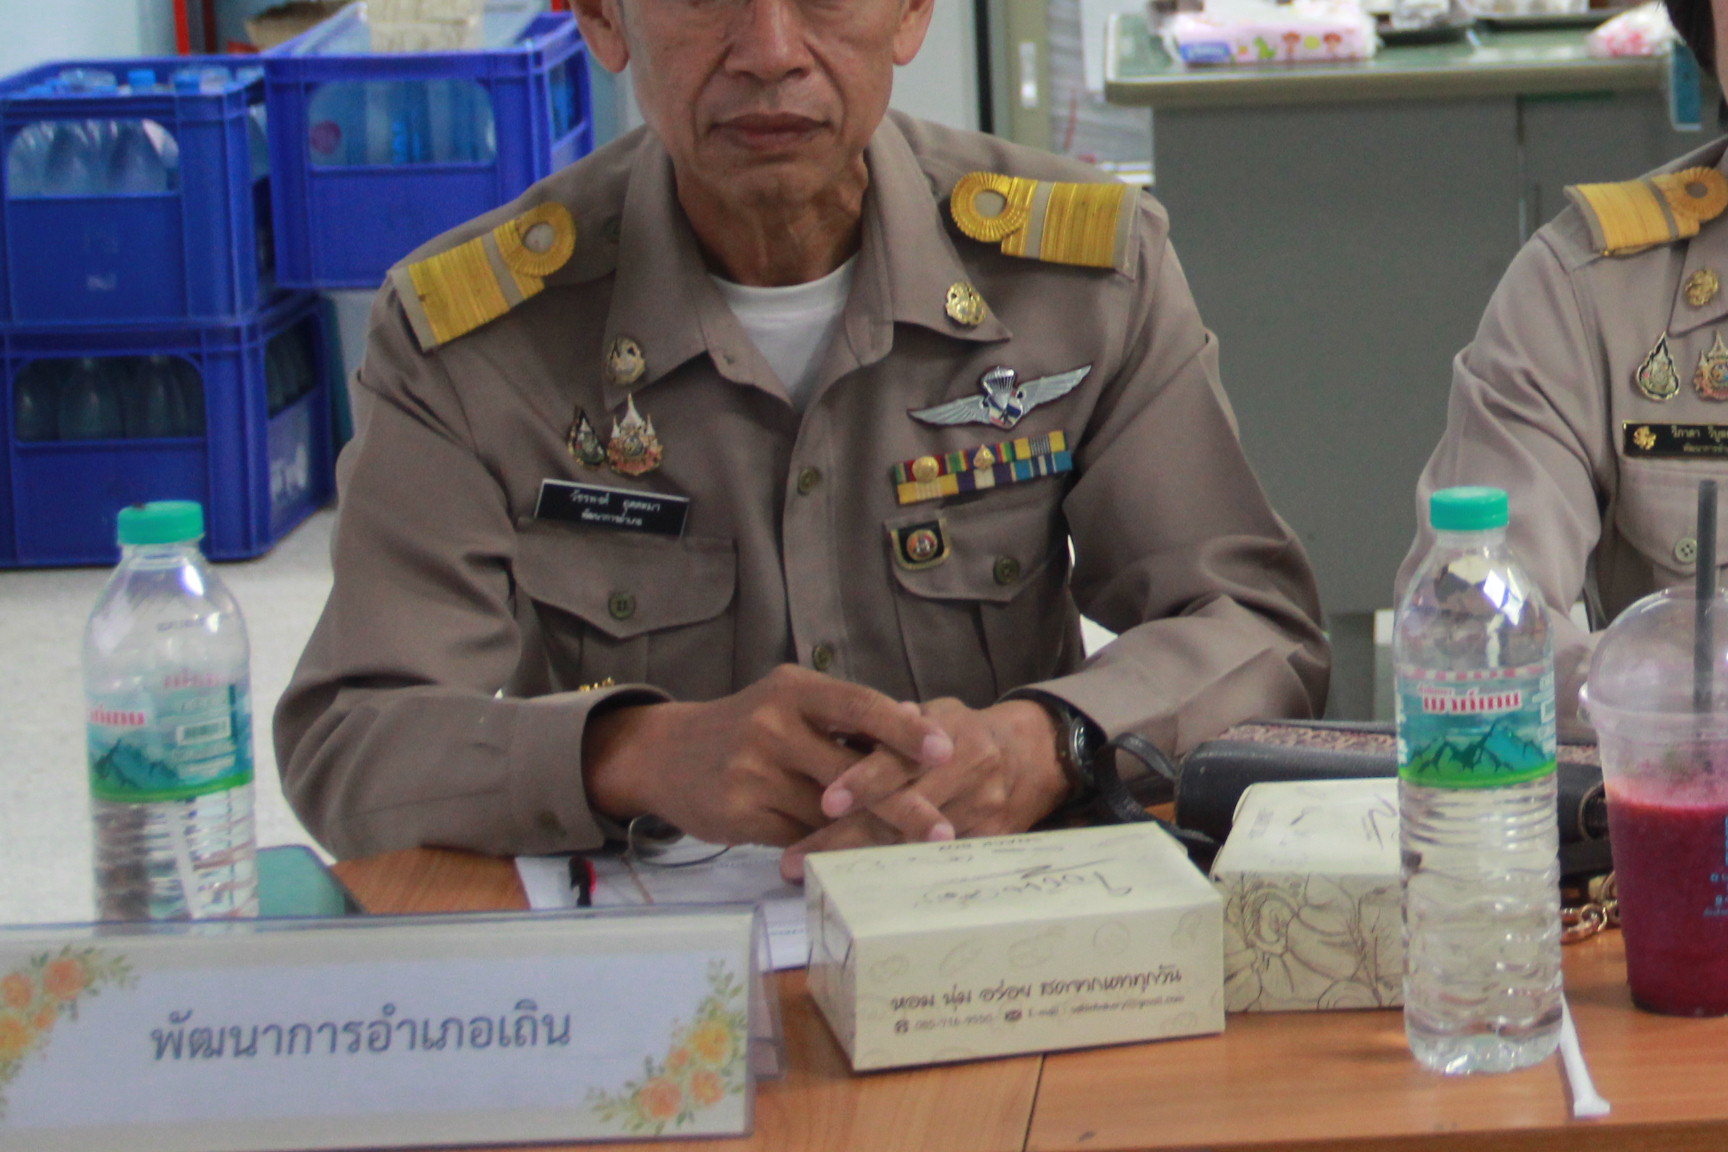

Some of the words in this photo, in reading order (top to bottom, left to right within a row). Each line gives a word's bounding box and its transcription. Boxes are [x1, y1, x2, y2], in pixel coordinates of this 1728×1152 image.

[150, 998, 572, 1061] พัฒนาการอำเภอเถิน
